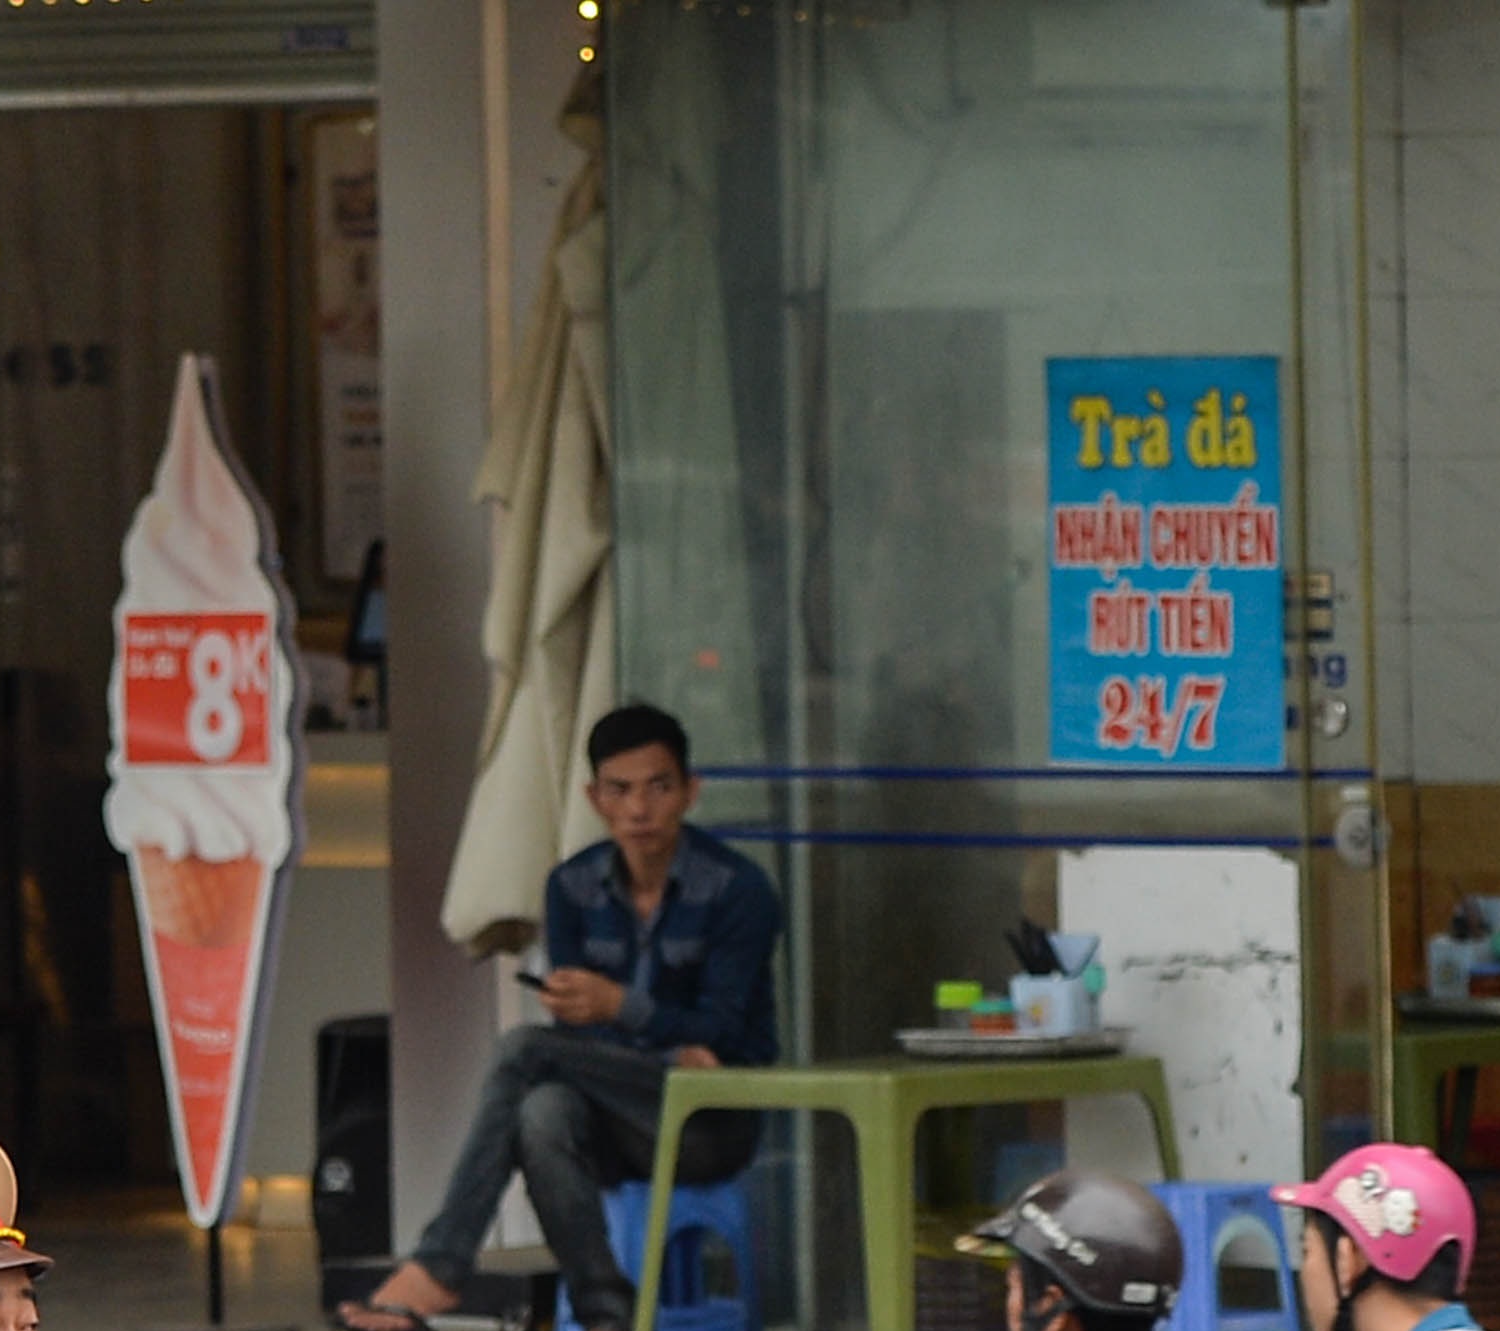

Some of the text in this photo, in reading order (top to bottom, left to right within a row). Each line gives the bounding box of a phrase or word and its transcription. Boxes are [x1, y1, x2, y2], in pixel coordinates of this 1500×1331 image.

[1069, 388, 1257, 468] Trà đá
[1054, 490, 1144, 582] NHẬN
[1099, 672, 1227, 757] 24/7
